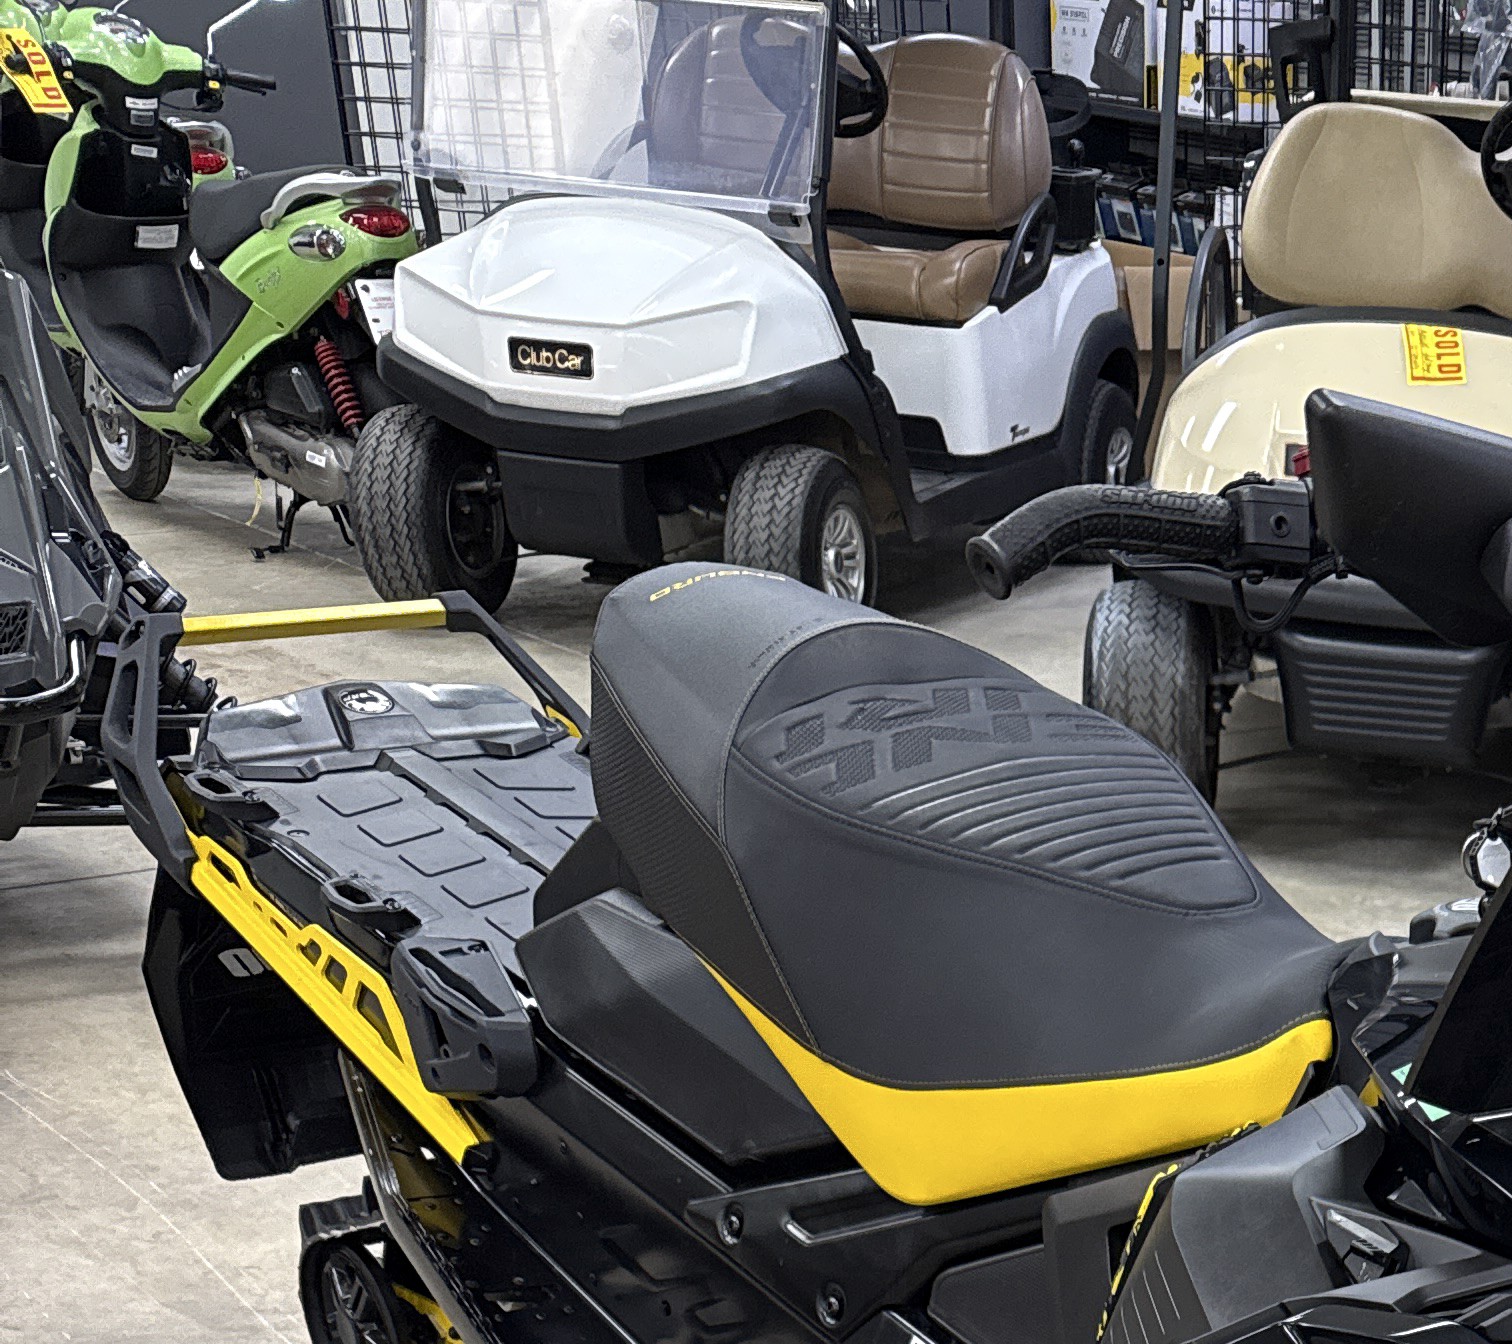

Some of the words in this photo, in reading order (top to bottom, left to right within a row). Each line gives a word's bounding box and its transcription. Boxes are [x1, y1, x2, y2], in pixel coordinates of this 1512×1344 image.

[16, 39, 62, 100] SOLD
[517, 344, 554, 368] Club
[554, 348, 584, 371] Car
[1433, 329, 1462, 375] SOLD
